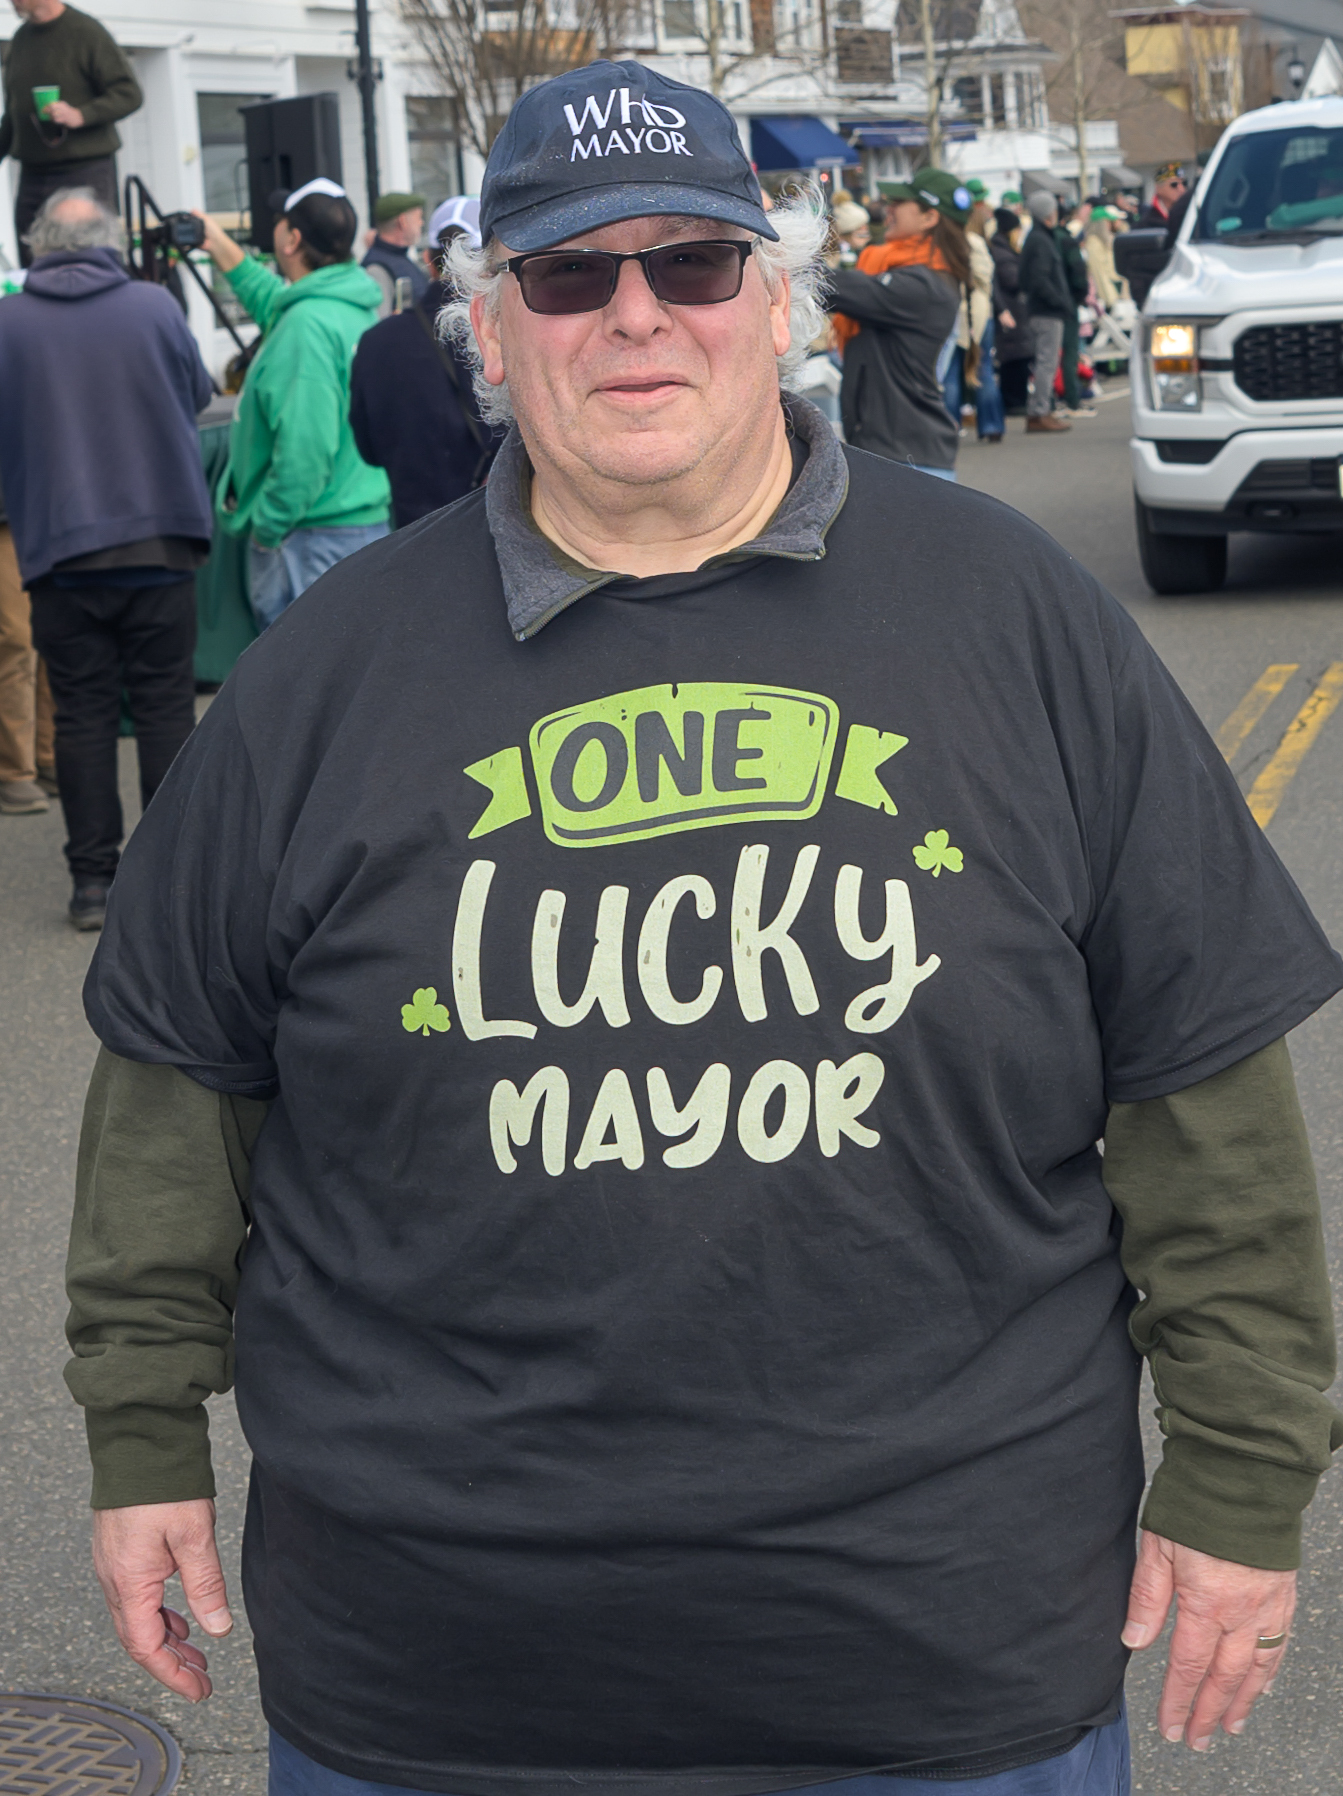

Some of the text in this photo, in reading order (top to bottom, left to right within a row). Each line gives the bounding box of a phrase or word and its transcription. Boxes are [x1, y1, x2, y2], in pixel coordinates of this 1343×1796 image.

[570, 127, 694, 162] MAYOR
[549, 708, 772, 813] ONE
[488, 1052, 886, 1177] MAYOR
